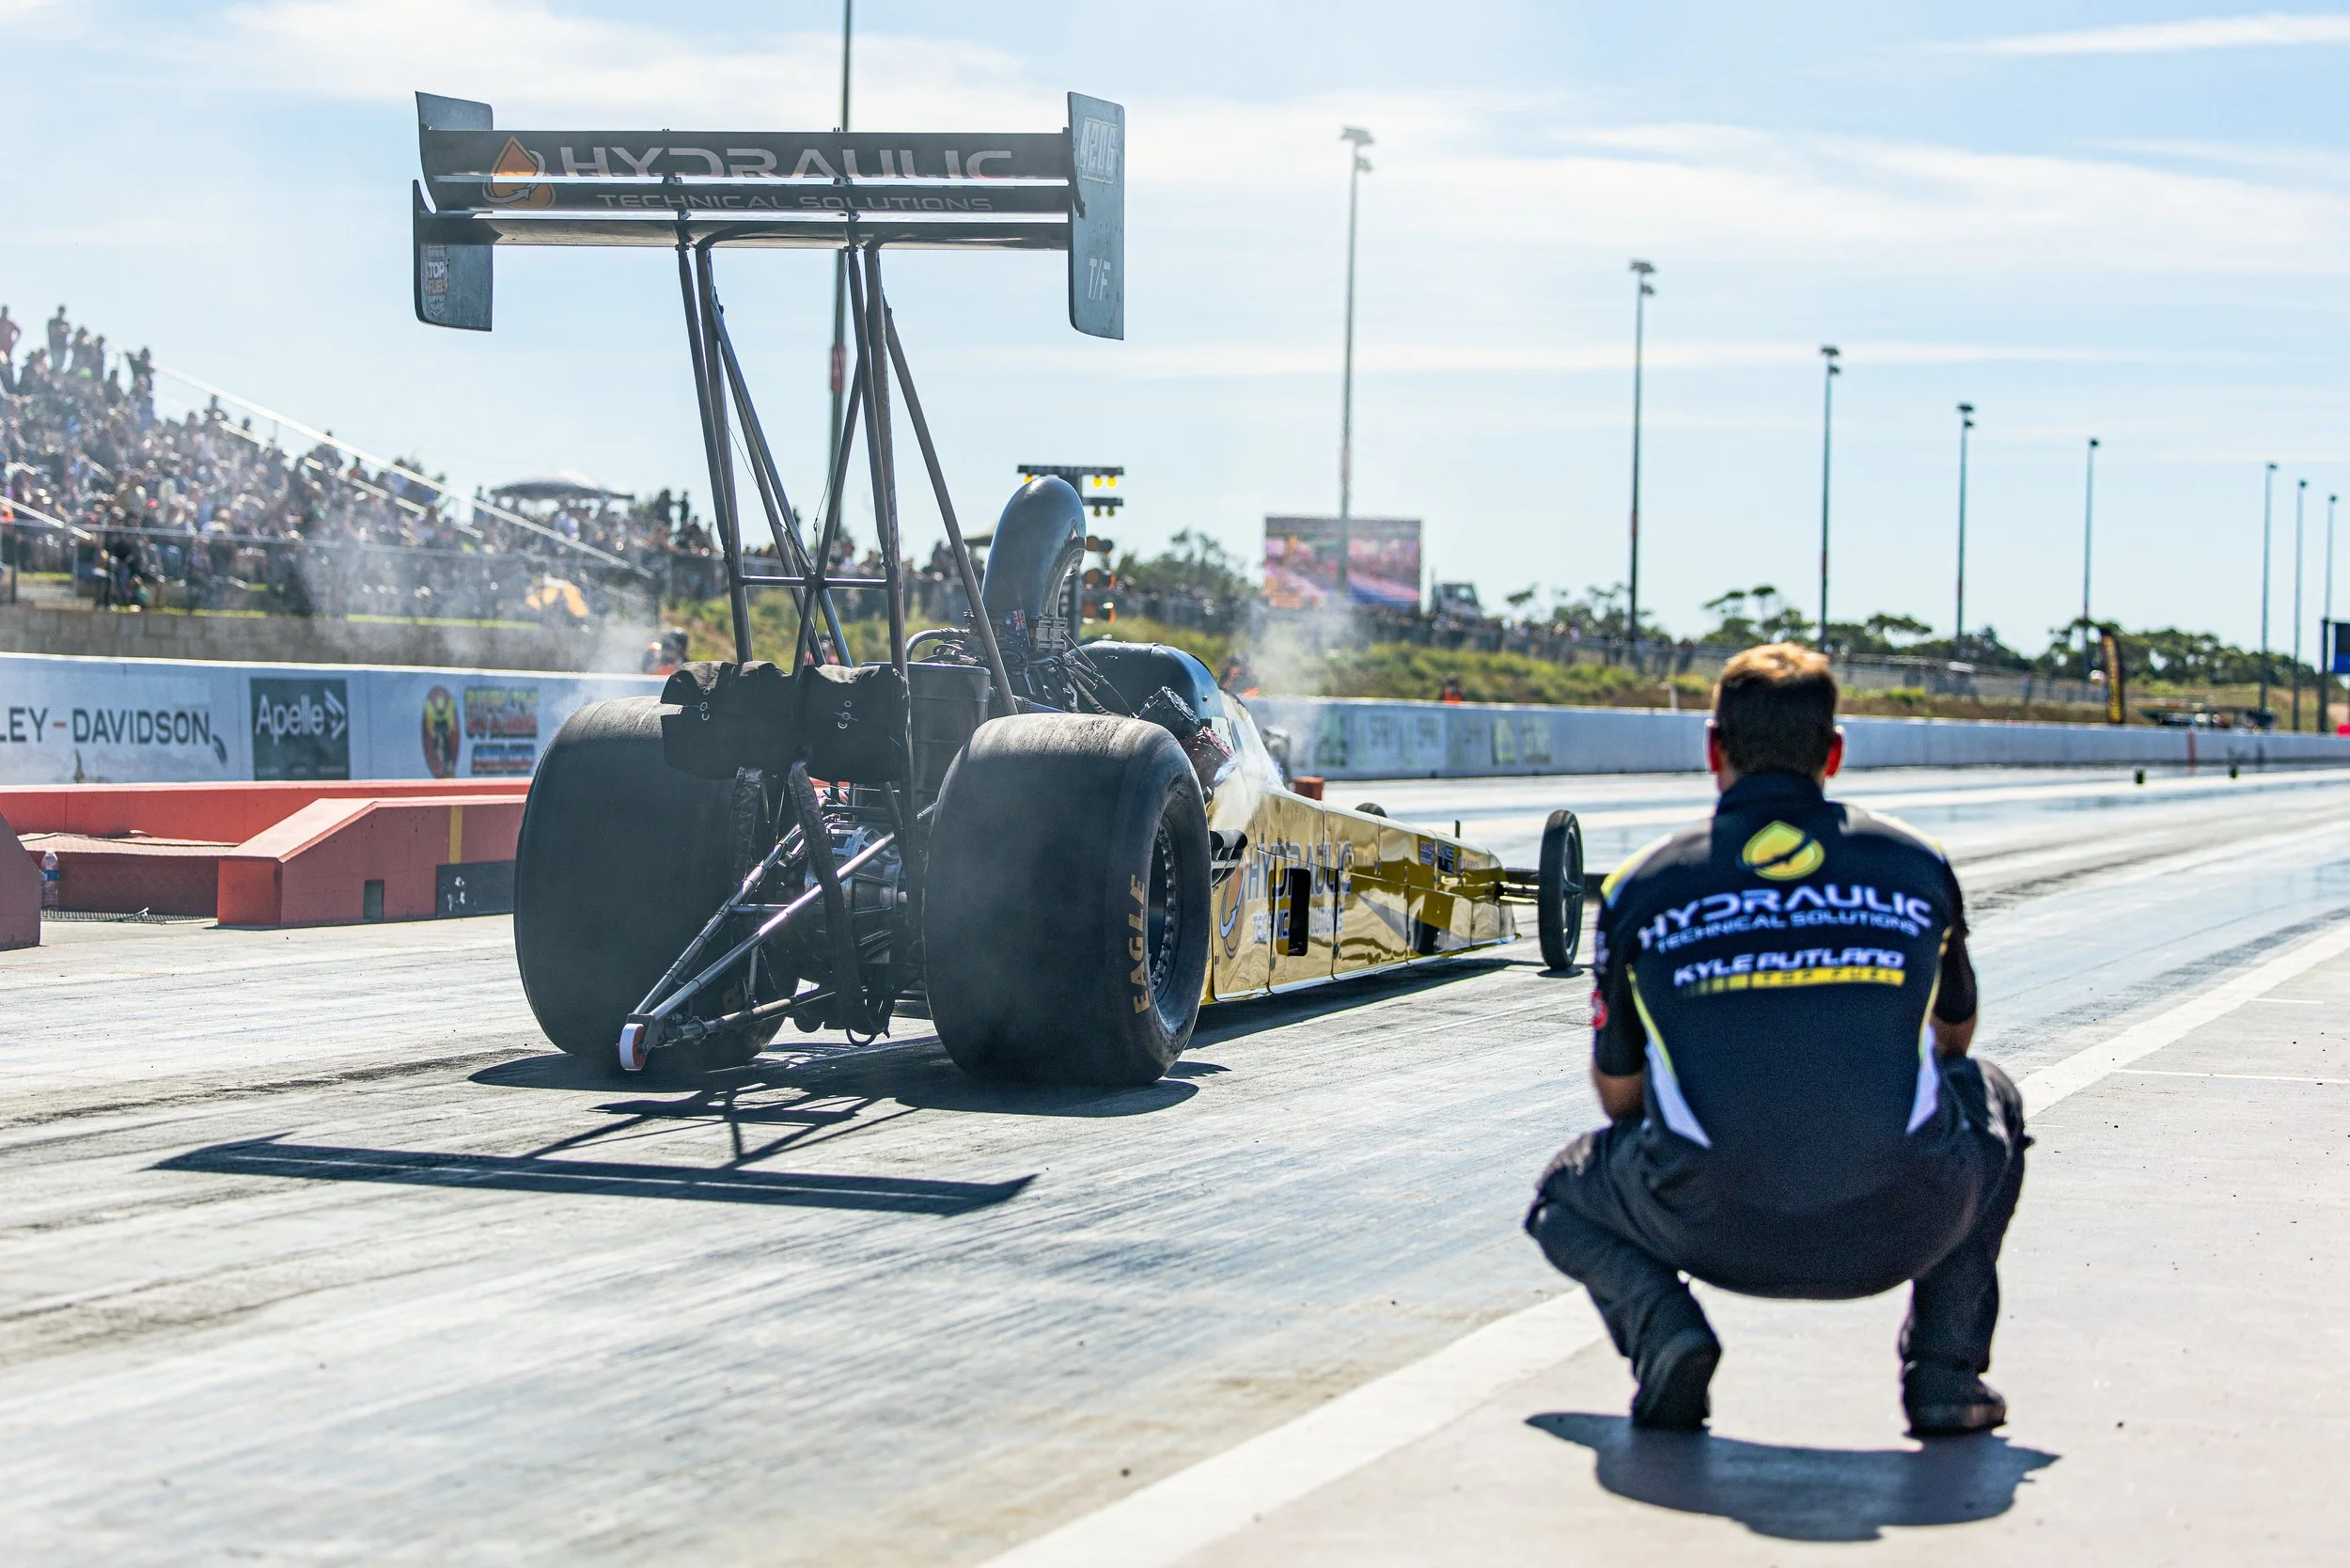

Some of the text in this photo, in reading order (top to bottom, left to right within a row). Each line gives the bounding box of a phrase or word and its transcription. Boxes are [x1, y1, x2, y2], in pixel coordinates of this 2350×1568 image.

[560, 147, 1014, 188] HYDRAULIC
[597, 194, 993, 211] TECHNICAL SOLUTIONS
[429, 261, 446, 278] TOP
[255, 694, 325, 745] Apelle
[1637, 884, 1933, 949] HYDRAULIC
[1655, 910, 1920, 953] TECHNICAL SOLUTIONS
[1128, 873, 1151, 1014] EAGLE
[1673, 947, 1906, 987] KYLE PUTLAND
